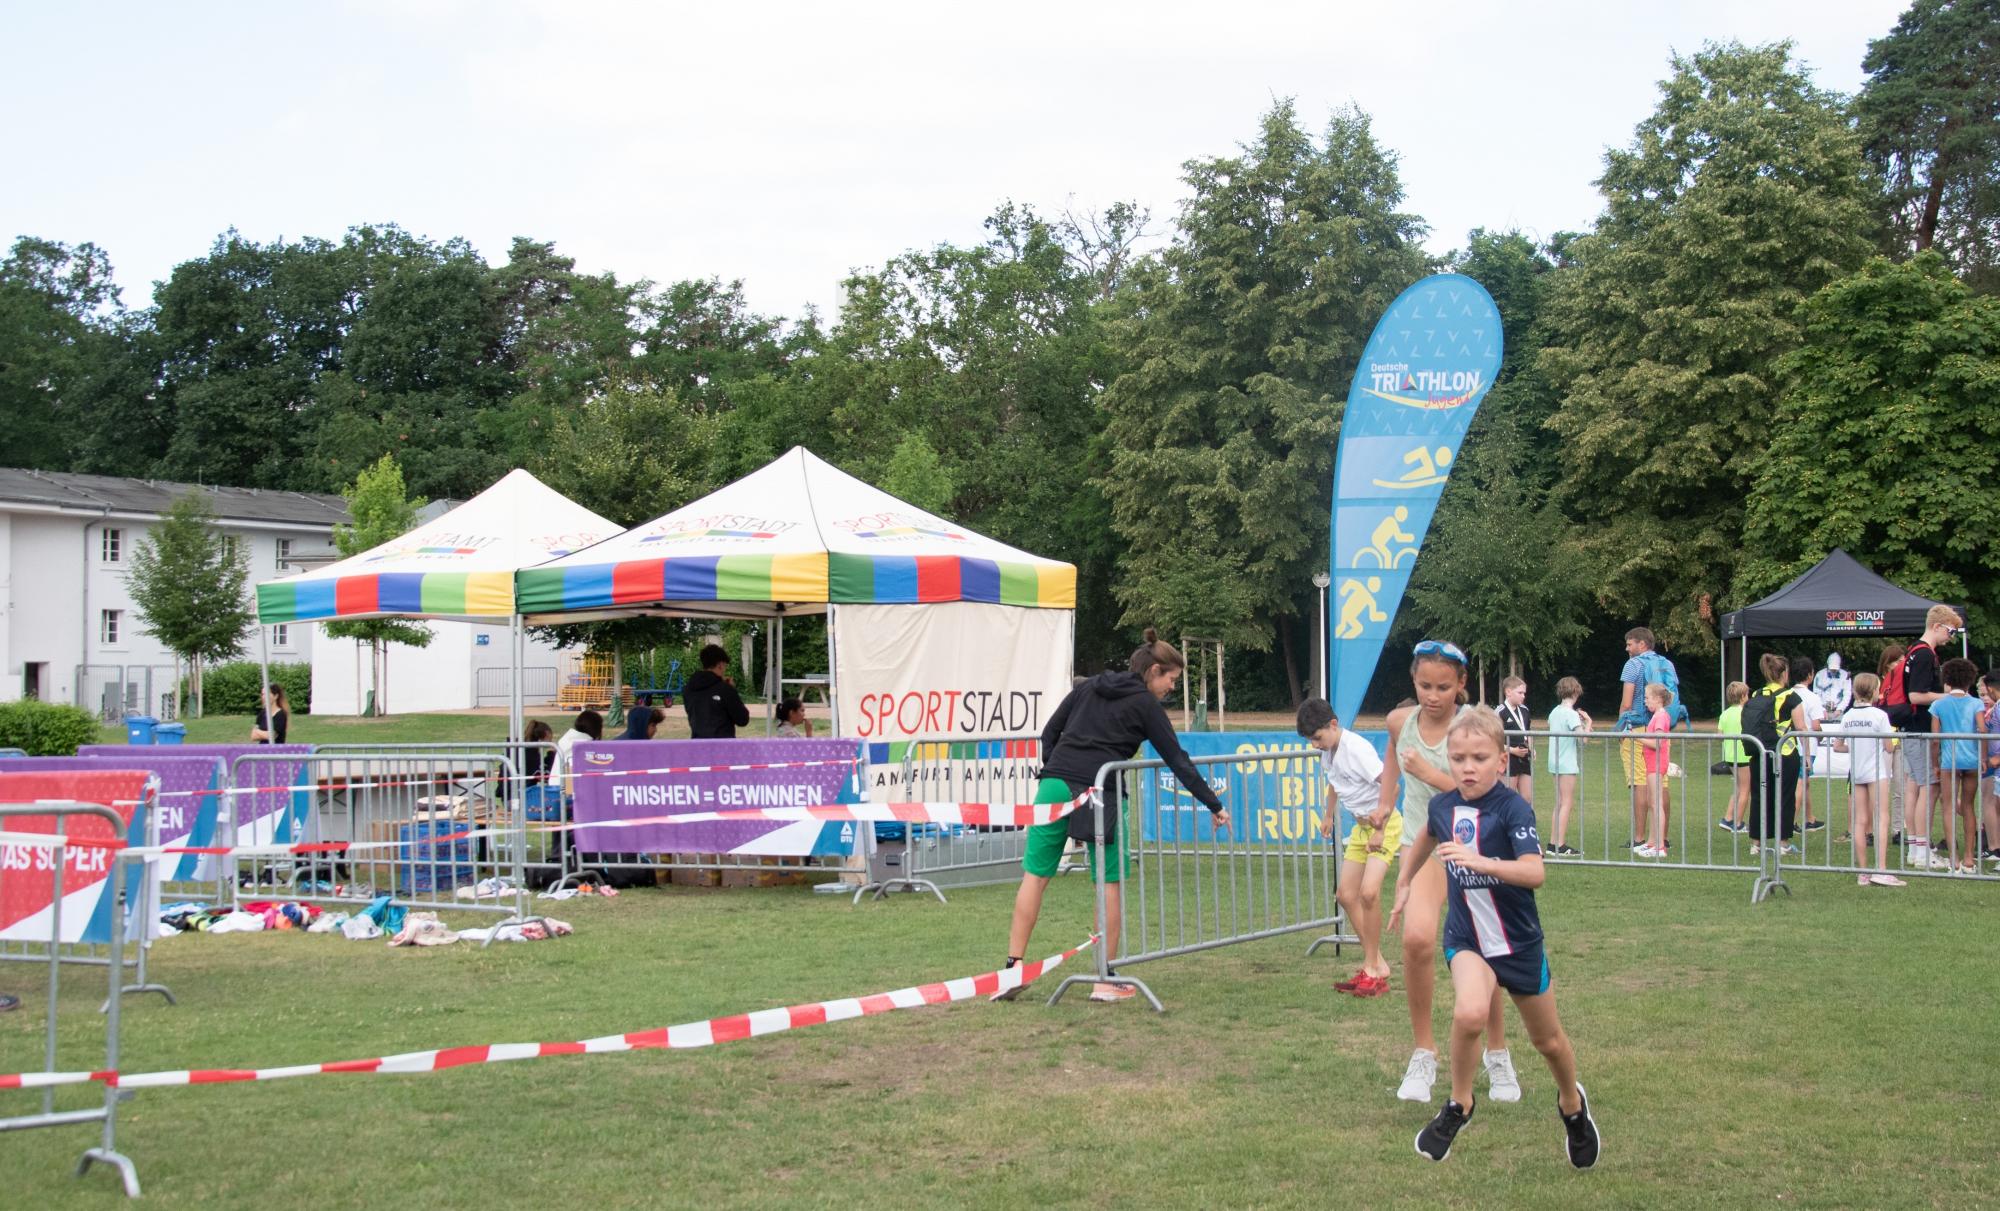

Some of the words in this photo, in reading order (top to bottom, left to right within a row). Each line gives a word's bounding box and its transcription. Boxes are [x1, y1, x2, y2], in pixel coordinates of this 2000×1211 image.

[1371, 363, 1408, 373] Deutsche
[1371, 371, 1481, 392] TRIATHLON
[1826, 610, 1885, 620] SPORTSTADT
[857, 691, 1043, 737] SPORTSTADT
[612, 785, 700, 806] FINISHEN
[718, 785, 822, 806] GEWINNEN
